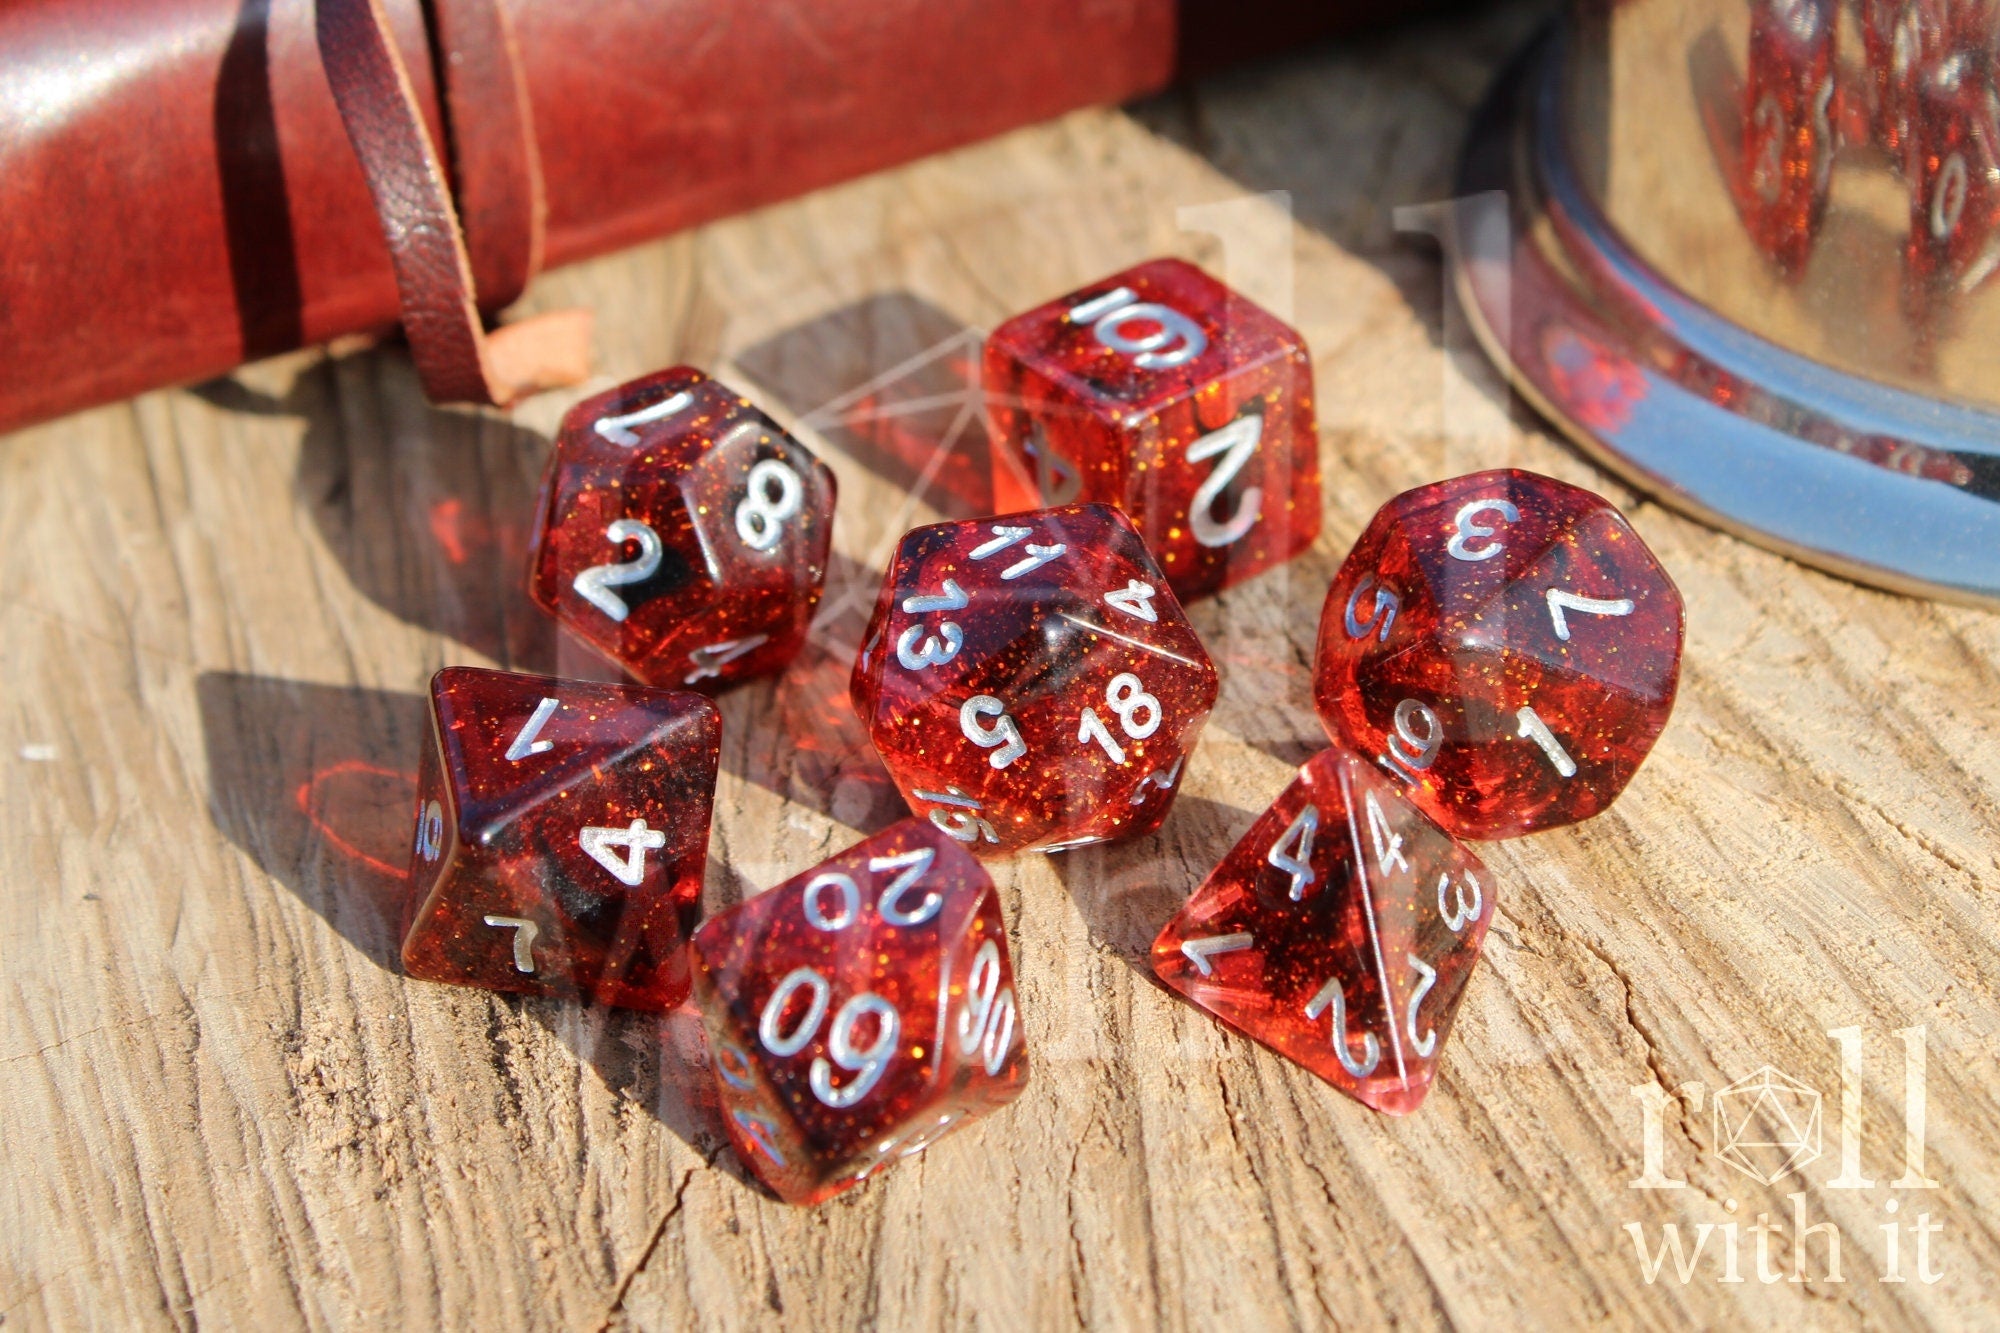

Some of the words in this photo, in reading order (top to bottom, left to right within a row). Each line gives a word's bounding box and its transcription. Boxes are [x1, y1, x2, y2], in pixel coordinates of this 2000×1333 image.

[735, 458, 803, 551] 8
[1186, 413, 1264, 548] 2
[573, 518, 663, 622] 2
[968, 525, 1067, 580] 11
[1447, 499, 1522, 562] 3
[897, 578, 969, 671] 13
[1103, 579, 1159, 622] 4
[1344, 573, 1400, 641] 5
[960, 695, 1028, 769] 5
[1077, 672, 1162, 765] 18
[1516, 706, 1578, 778] 1
[579, 818, 666, 886] 4
[1268, 804, 1320, 901] 4
[1364, 788, 1409, 878] 4
[803, 847, 943, 931] 20
[1437, 868, 1484, 932] 3
[1181, 931, 1254, 976] 1
[1304, 976, 1381, 1078] 2
[1408, 952, 1437, 1058] 2
